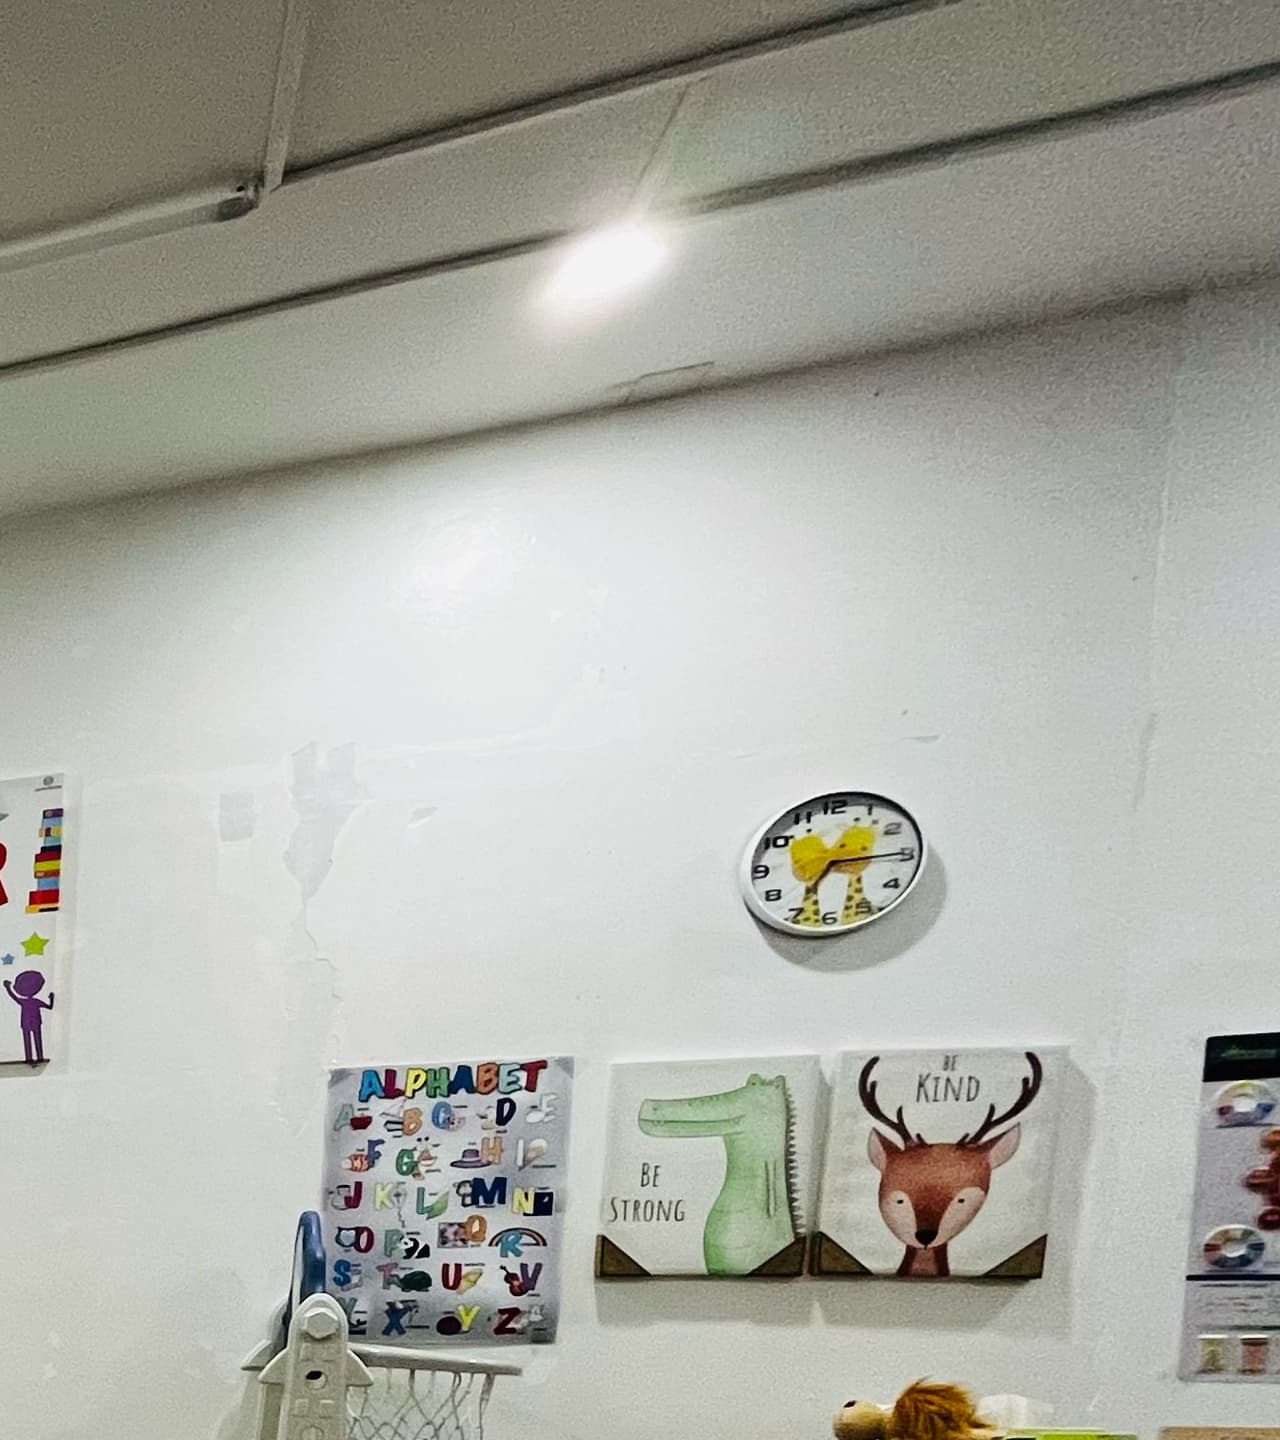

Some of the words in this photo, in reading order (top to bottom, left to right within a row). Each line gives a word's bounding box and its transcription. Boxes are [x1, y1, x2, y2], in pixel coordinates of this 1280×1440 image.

[793, 811, 812, 825] 11
[823, 800, 848, 815] 12
[883, 822, 902, 836] 2
[764, 835, 793, 850] 10
[752, 864, 770, 880] 9
[882, 878, 900, 889] 4
[765, 889, 782, 902] 8
[822, 911, 838, 925] 6
[942, 1054, 958, 1072] BE
[358, 1060, 548, 1102] ALPHABET
[916, 1074, 981, 1103] KIND
[334, 1103, 354, 1130] A
[402, 1108, 422, 1136] B
[496, 1098, 516, 1126] D
[367, 1139, 386, 1168] F
[396, 1148, 418, 1176] G
[480, 1136, 504, 1165] H
[640, 1162, 661, 1188] BE
[344, 1181, 362, 1209] J
[374, 1183, 394, 1209] K
[471, 1177, 508, 1205] M
[512, 1186, 535, 1214] N
[608, 1197, 686, 1223] STRONG
[354, 1226, 374, 1253] O
[384, 1229, 405, 1257] P
[500, 1230, 522, 1257] R
[334, 1260, 351, 1288] S
[442, 1263, 462, 1291] U
[520, 1262, 542, 1290] V
[382, 1301, 410, 1335] X
[456, 1304, 480, 1332] Y
[494, 1307, 521, 1334] Z
